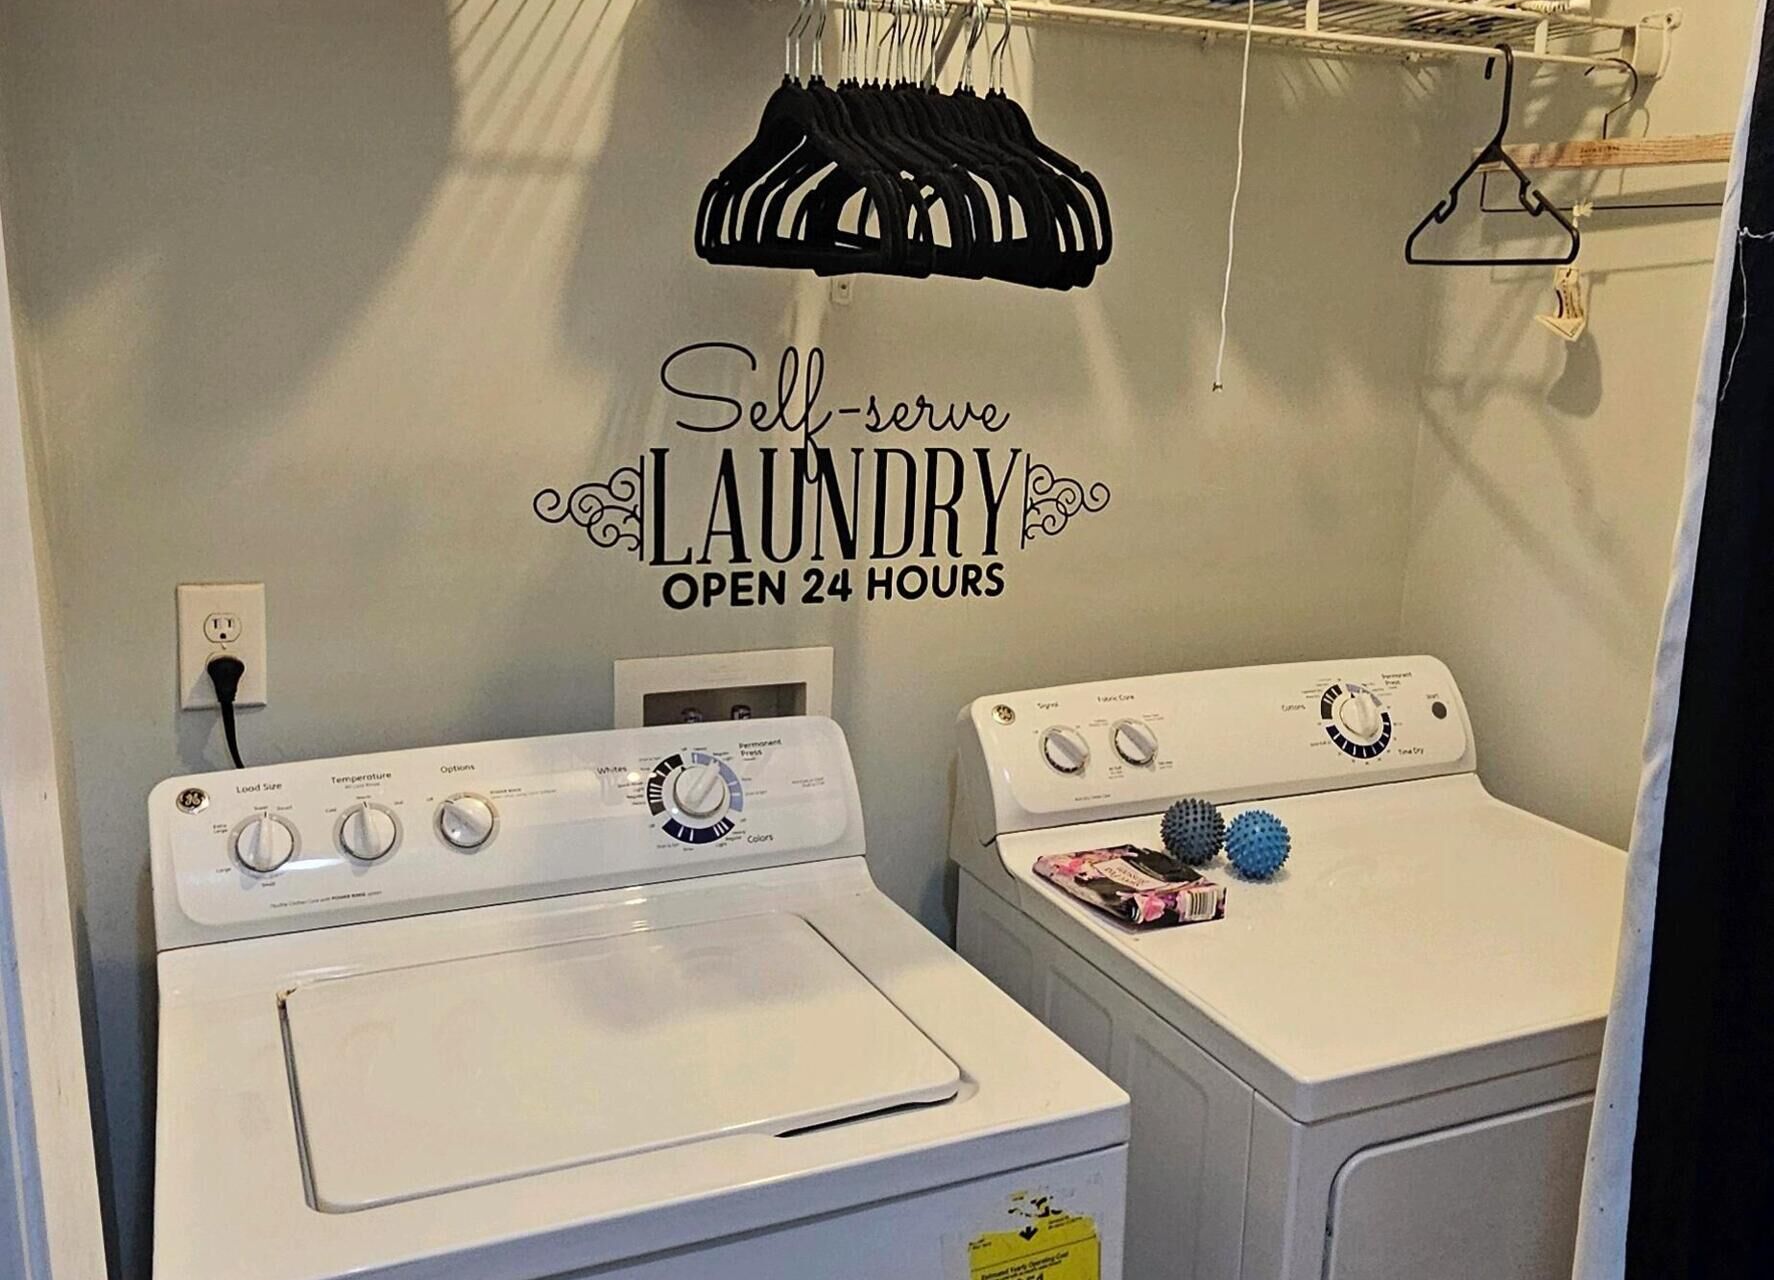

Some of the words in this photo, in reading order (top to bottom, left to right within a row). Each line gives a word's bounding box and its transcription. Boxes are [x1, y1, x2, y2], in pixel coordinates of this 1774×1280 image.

[660, 341, 1011, 484] Self-serve
[649, 446, 1023, 565] LAUNDRY
[662, 570, 786, 610] OPEN
[801, 567, 853, 605] 24
[867, 562, 1005, 601] HOURS
[738, 738, 782, 750] Permanent
[740, 749, 763, 758] Press
[440, 763, 475, 774] Options
[597, 765, 628, 775] Whites
[331, 772, 392, 784] Temperature
[236, 786, 261, 794] Load
[263, 783, 282, 791] Size
[747, 833, 774, 845] Colors
